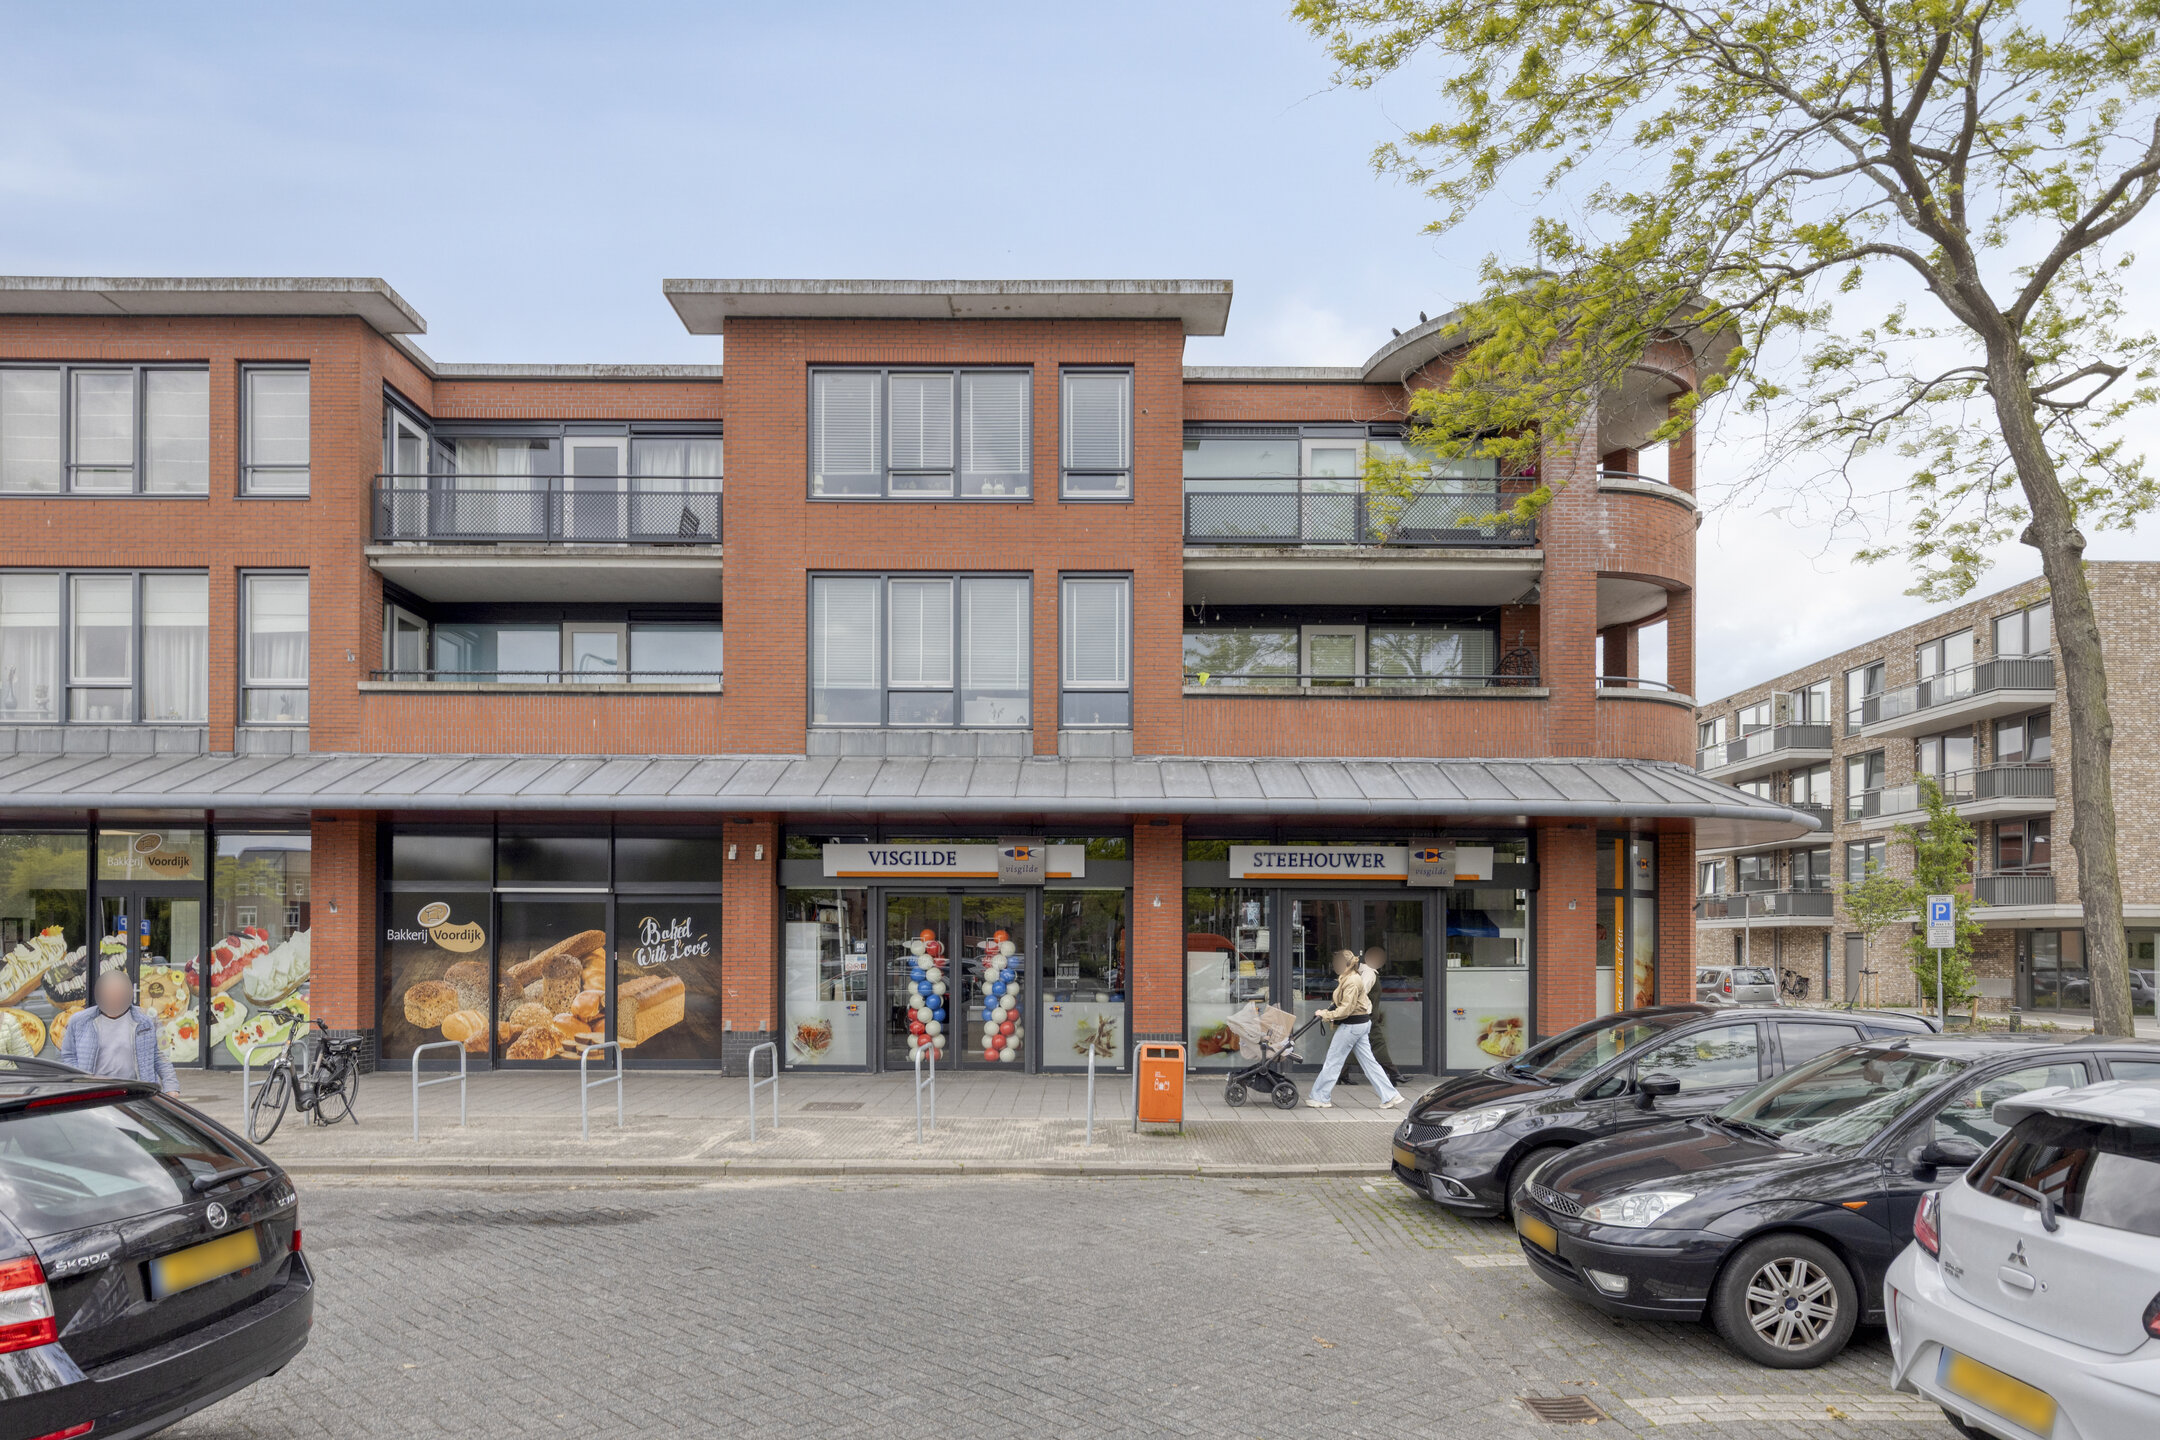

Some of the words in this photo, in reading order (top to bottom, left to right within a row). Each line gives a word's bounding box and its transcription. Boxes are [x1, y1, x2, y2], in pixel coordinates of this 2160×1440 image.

[107, 856, 143, 869] Bakkerij
[148, 856, 190, 869] Voordijk
[867, 850, 957, 866] VISGILDE
[1253, 852, 1386, 868] STEEHOUWER
[1005, 864, 1039, 874] visgilde
[1415, 866, 1447, 877] visgilde
[1935, 904, 1947, 920] P
[387, 928, 428, 944] Bakkerij
[433, 929, 481, 943] Voordijk
[641, 917, 693, 946] Baked
[637, 943, 669, 966] With
[670, 939, 711, 961] Love
